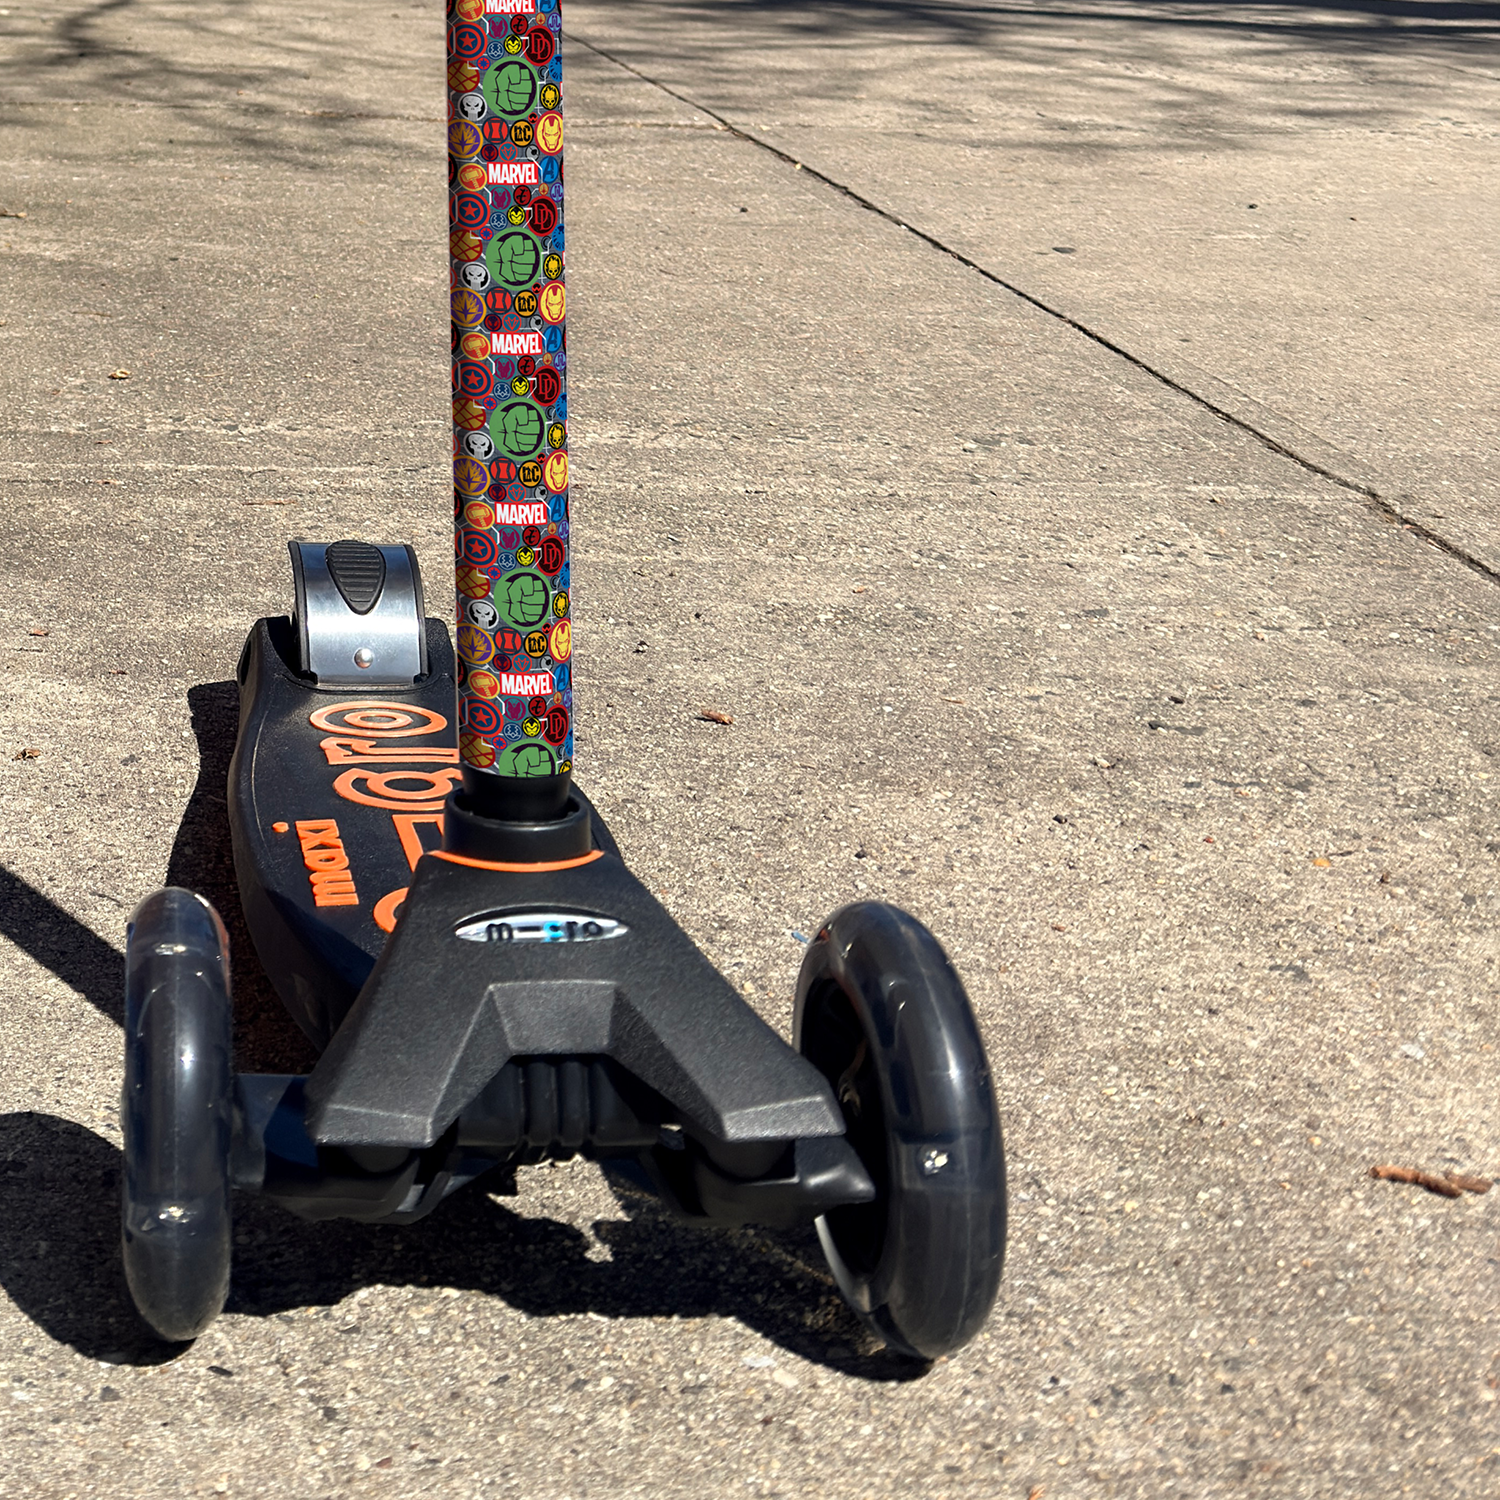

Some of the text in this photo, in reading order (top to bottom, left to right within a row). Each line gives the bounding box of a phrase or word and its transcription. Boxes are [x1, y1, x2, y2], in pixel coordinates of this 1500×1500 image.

[488, 163, 537, 184] MARVEL
[491, 333, 541, 355] MARVEL
[496, 503, 546, 525] MARVEL
[501, 673, 552, 695] MARVEL
[272, 819, 359, 907] maxi
